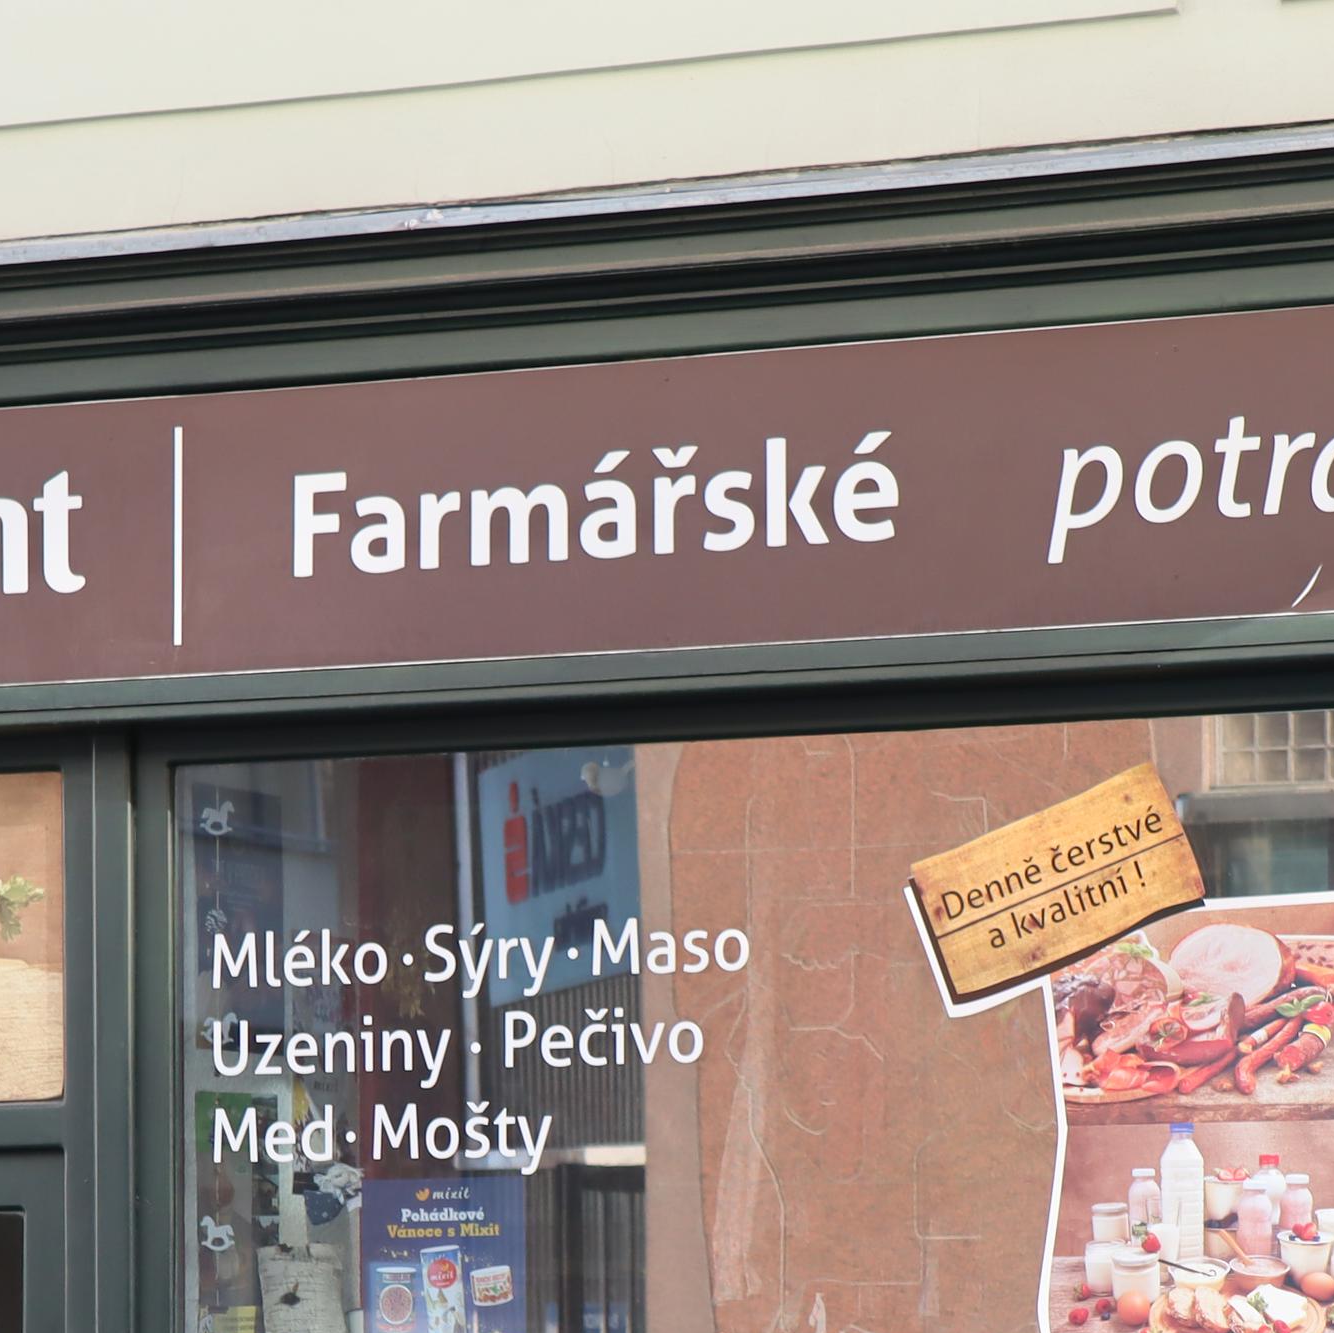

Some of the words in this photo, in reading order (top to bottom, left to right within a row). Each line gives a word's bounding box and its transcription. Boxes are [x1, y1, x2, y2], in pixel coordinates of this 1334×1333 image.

[293, 431, 899, 578] Farmářské
[940, 856, 1042, 922] Denně
[1050, 805, 1163, 874] čerstvé
[988, 927, 1005, 948] a
[1010, 866, 1128, 940] kvalitní
[212, 928, 389, 989] Mléko
[424, 922, 556, 999] Sýry
[591, 917, 750, 975] Maso
[212, 1015, 452, 1090] Uzeniny
[504, 1007, 705, 1068] Pečivo
[213, 1104, 333, 1164] Med
[373, 1101, 553, 1175] Mošty
[387, 1224, 442, 1238] Vánoce
[447, 1227, 456, 1237] s
[460, 1223, 500, 1237] Mixit
[401, 1207, 485, 1222] Pohádkové
[432, 1187, 471, 1200] mixit
